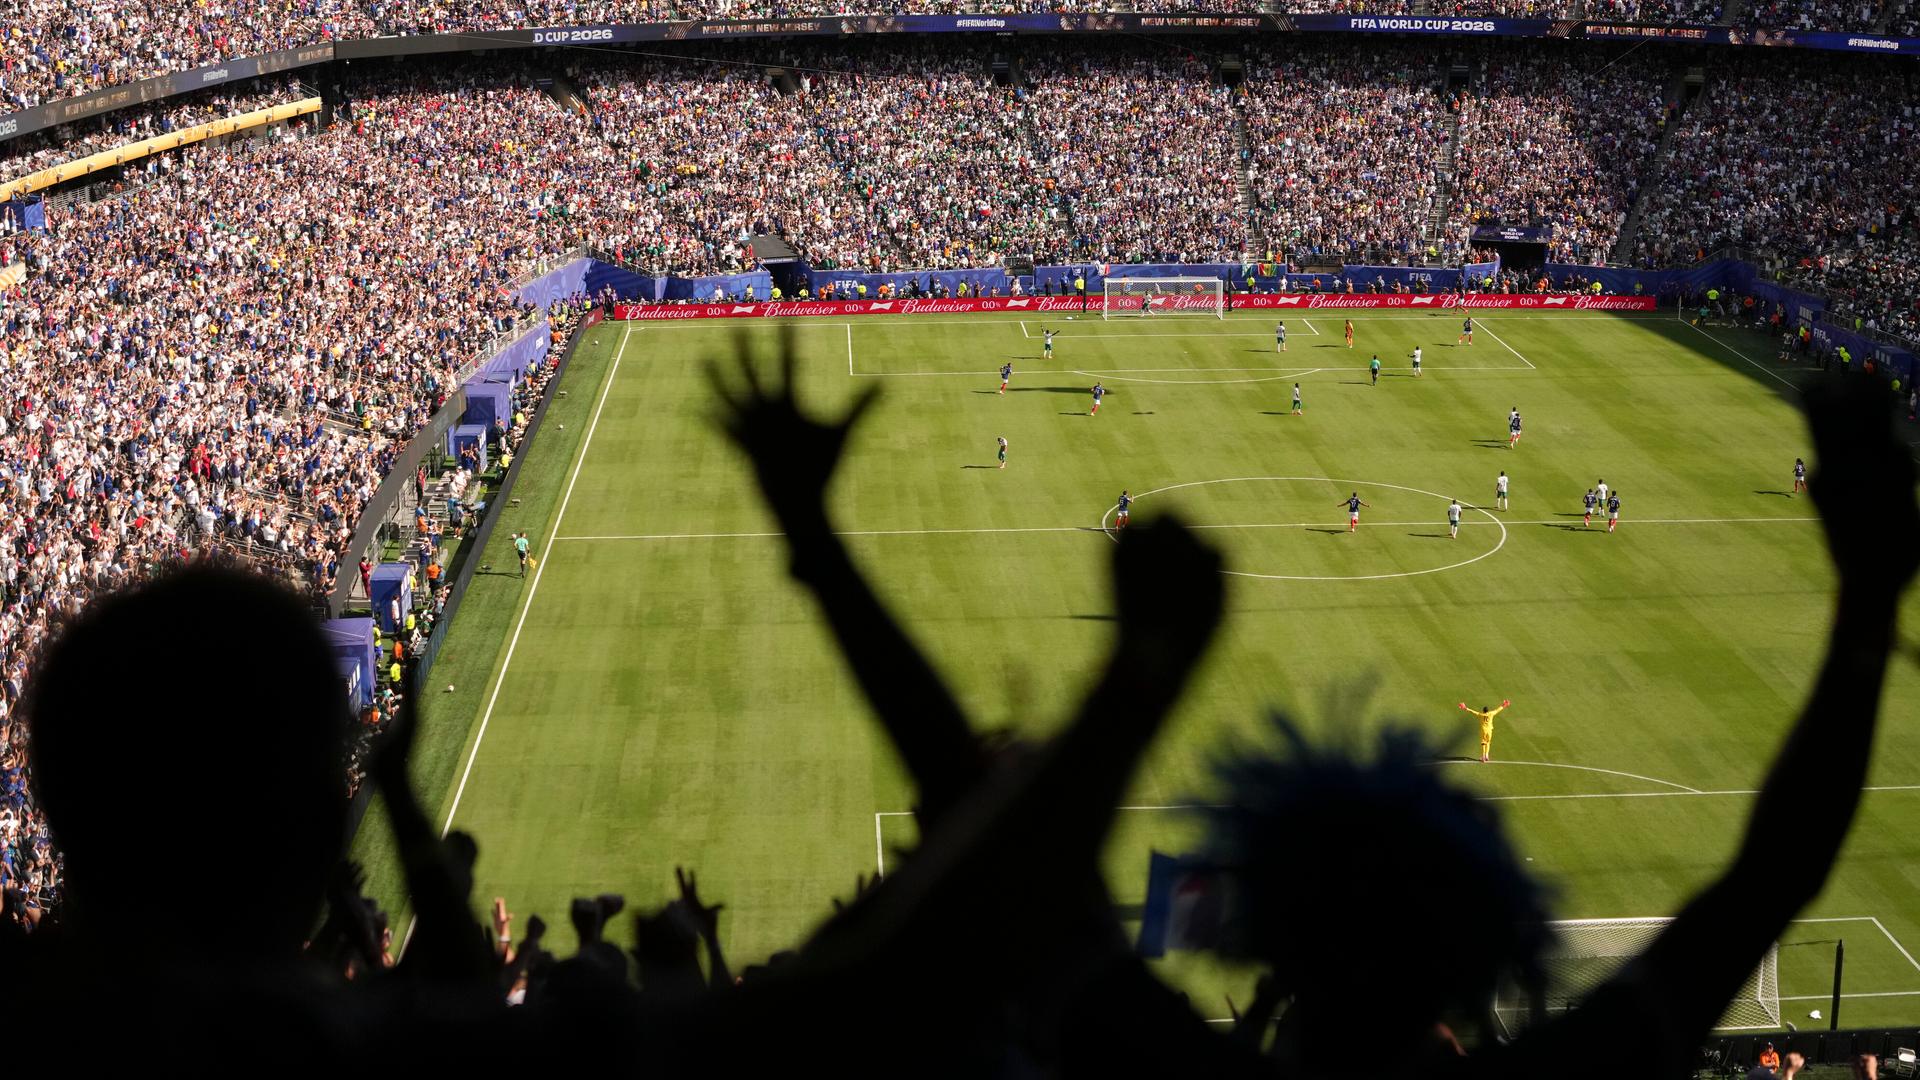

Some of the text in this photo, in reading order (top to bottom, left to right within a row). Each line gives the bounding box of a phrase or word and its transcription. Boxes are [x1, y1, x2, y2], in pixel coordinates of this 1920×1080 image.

[702, 25, 726, 34] NEW
[756, 23, 780, 33] NEW
[956, 18, 1006, 28] #FIFAWorldCup
[1141, 17, 1165, 26] NEW
[1196, 17, 1220, 26] NEW
[1350, 18, 1495, 32] FIFA WORLD CUP 2026
[533, 29, 613, 43] D CUP 2026
[1586, 25, 1610, 35] NEW
[1642, 27, 1665, 37] NEW
[1409, 272, 1433, 282] FIFA
[835, 280, 859, 289] FIFA
[899, 299, 974, 314] Budweiser
[1306, 294, 1380, 308] Budweiser
[1440, 293, 1512, 308] Bdweiser
[1572, 295, 1645, 310] Budweiser
[622, 305, 699, 320] Budweiser
[761, 302, 837, 317] Budweiser
